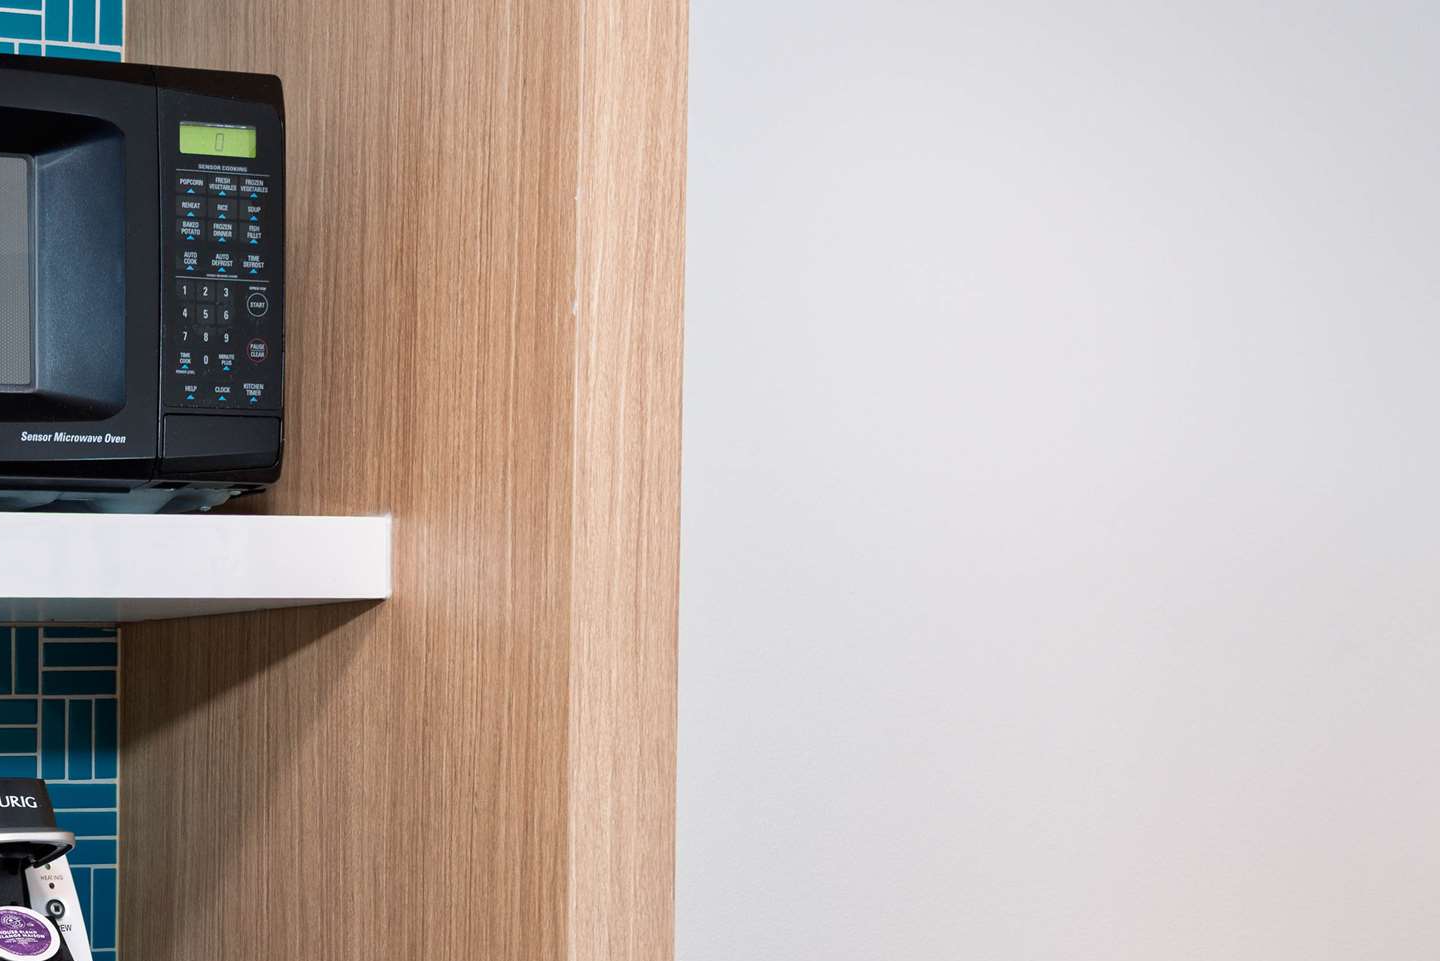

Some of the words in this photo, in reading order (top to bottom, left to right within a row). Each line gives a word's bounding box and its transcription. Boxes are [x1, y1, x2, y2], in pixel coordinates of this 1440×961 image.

[180, 178, 203, 186] POPCORN
[182, 285, 187, 296] 1
[203, 286, 208, 296] 2
[224, 287, 229, 297] 3
[182, 308, 188, 318] 4
[203, 309, 208, 319] 5
[224, 310, 229, 320] 6
[183, 331, 188, 341] 7
[203, 332, 208, 342] 8
[224, 333, 229, 343] 9
[203, 355, 208, 365] 0
[21, 431, 52, 442] Sensor
[54, 432, 102, 443] Microwave
[104, 433, 126, 444] Oven
